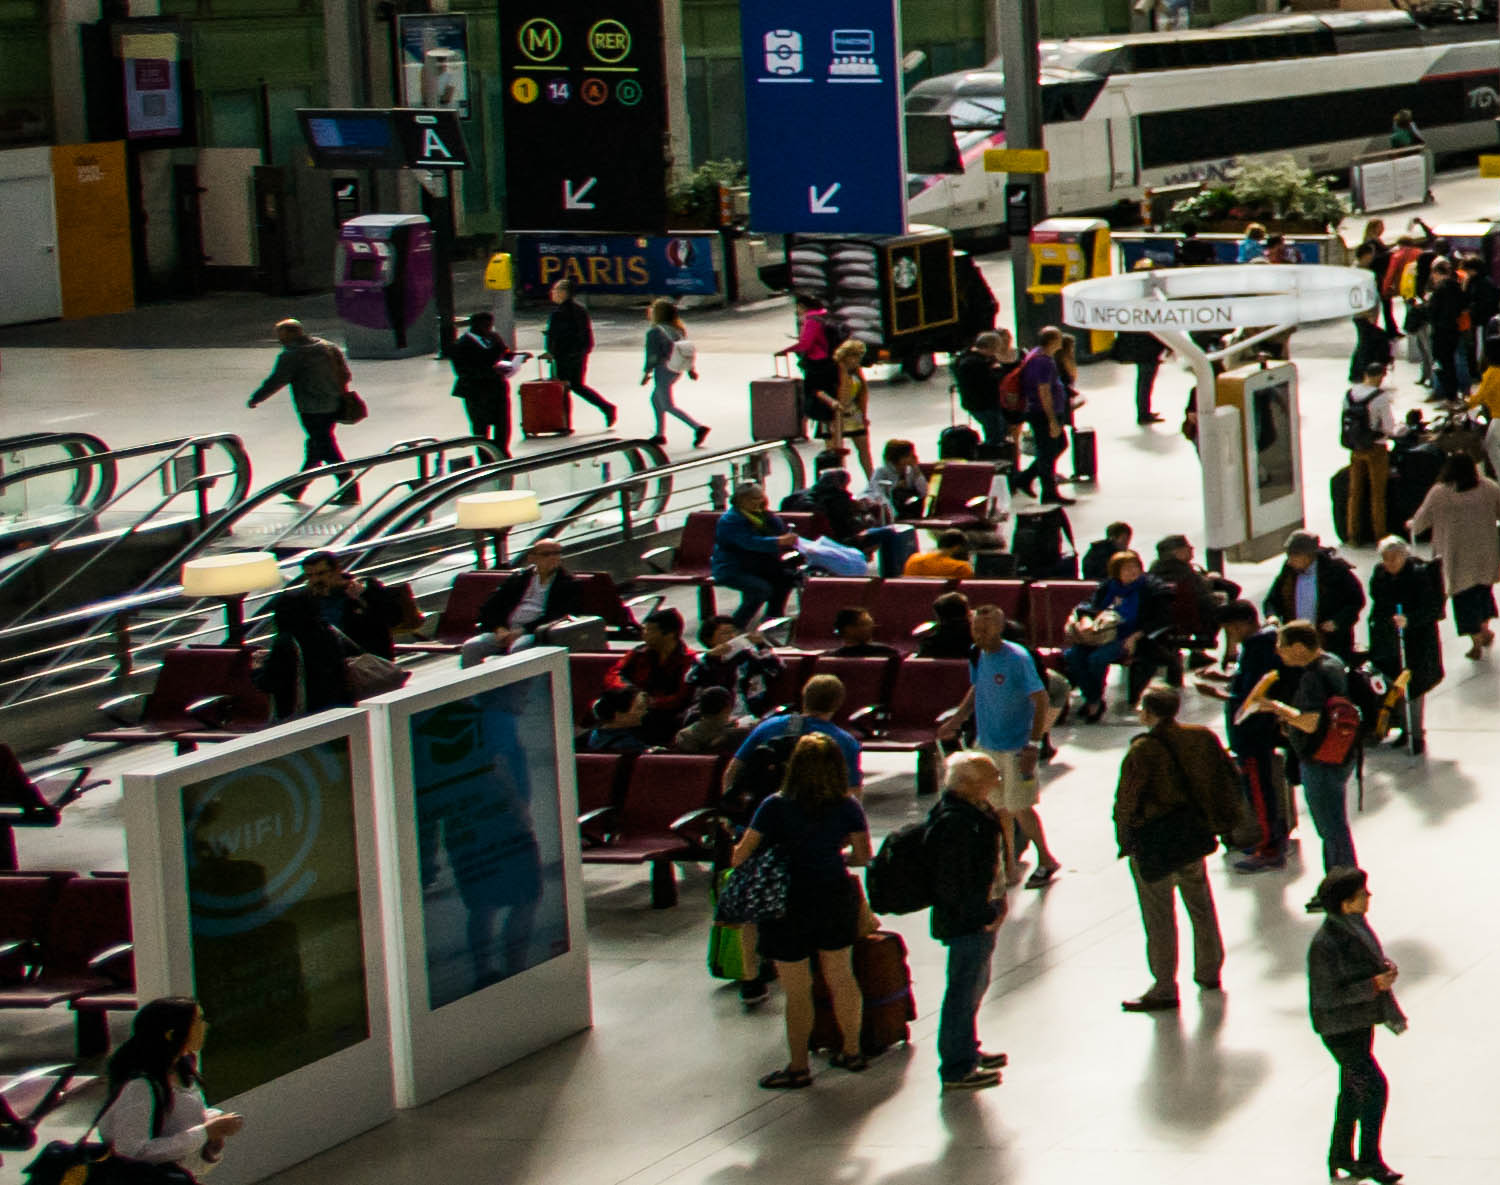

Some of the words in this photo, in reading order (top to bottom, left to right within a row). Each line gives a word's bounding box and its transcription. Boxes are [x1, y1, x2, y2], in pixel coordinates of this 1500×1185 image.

[529, 28, 553, 52] M
[594, 33, 627, 50] RER
[518, 84, 530, 99] 1
[549, 83, 570, 100] 14
[588, 85, 600, 98] A
[623, 86, 636, 100] D
[424, 129, 451, 157] A
[539, 256, 650, 285] PARIS
[1091, 305, 1233, 325] INFORMATION
